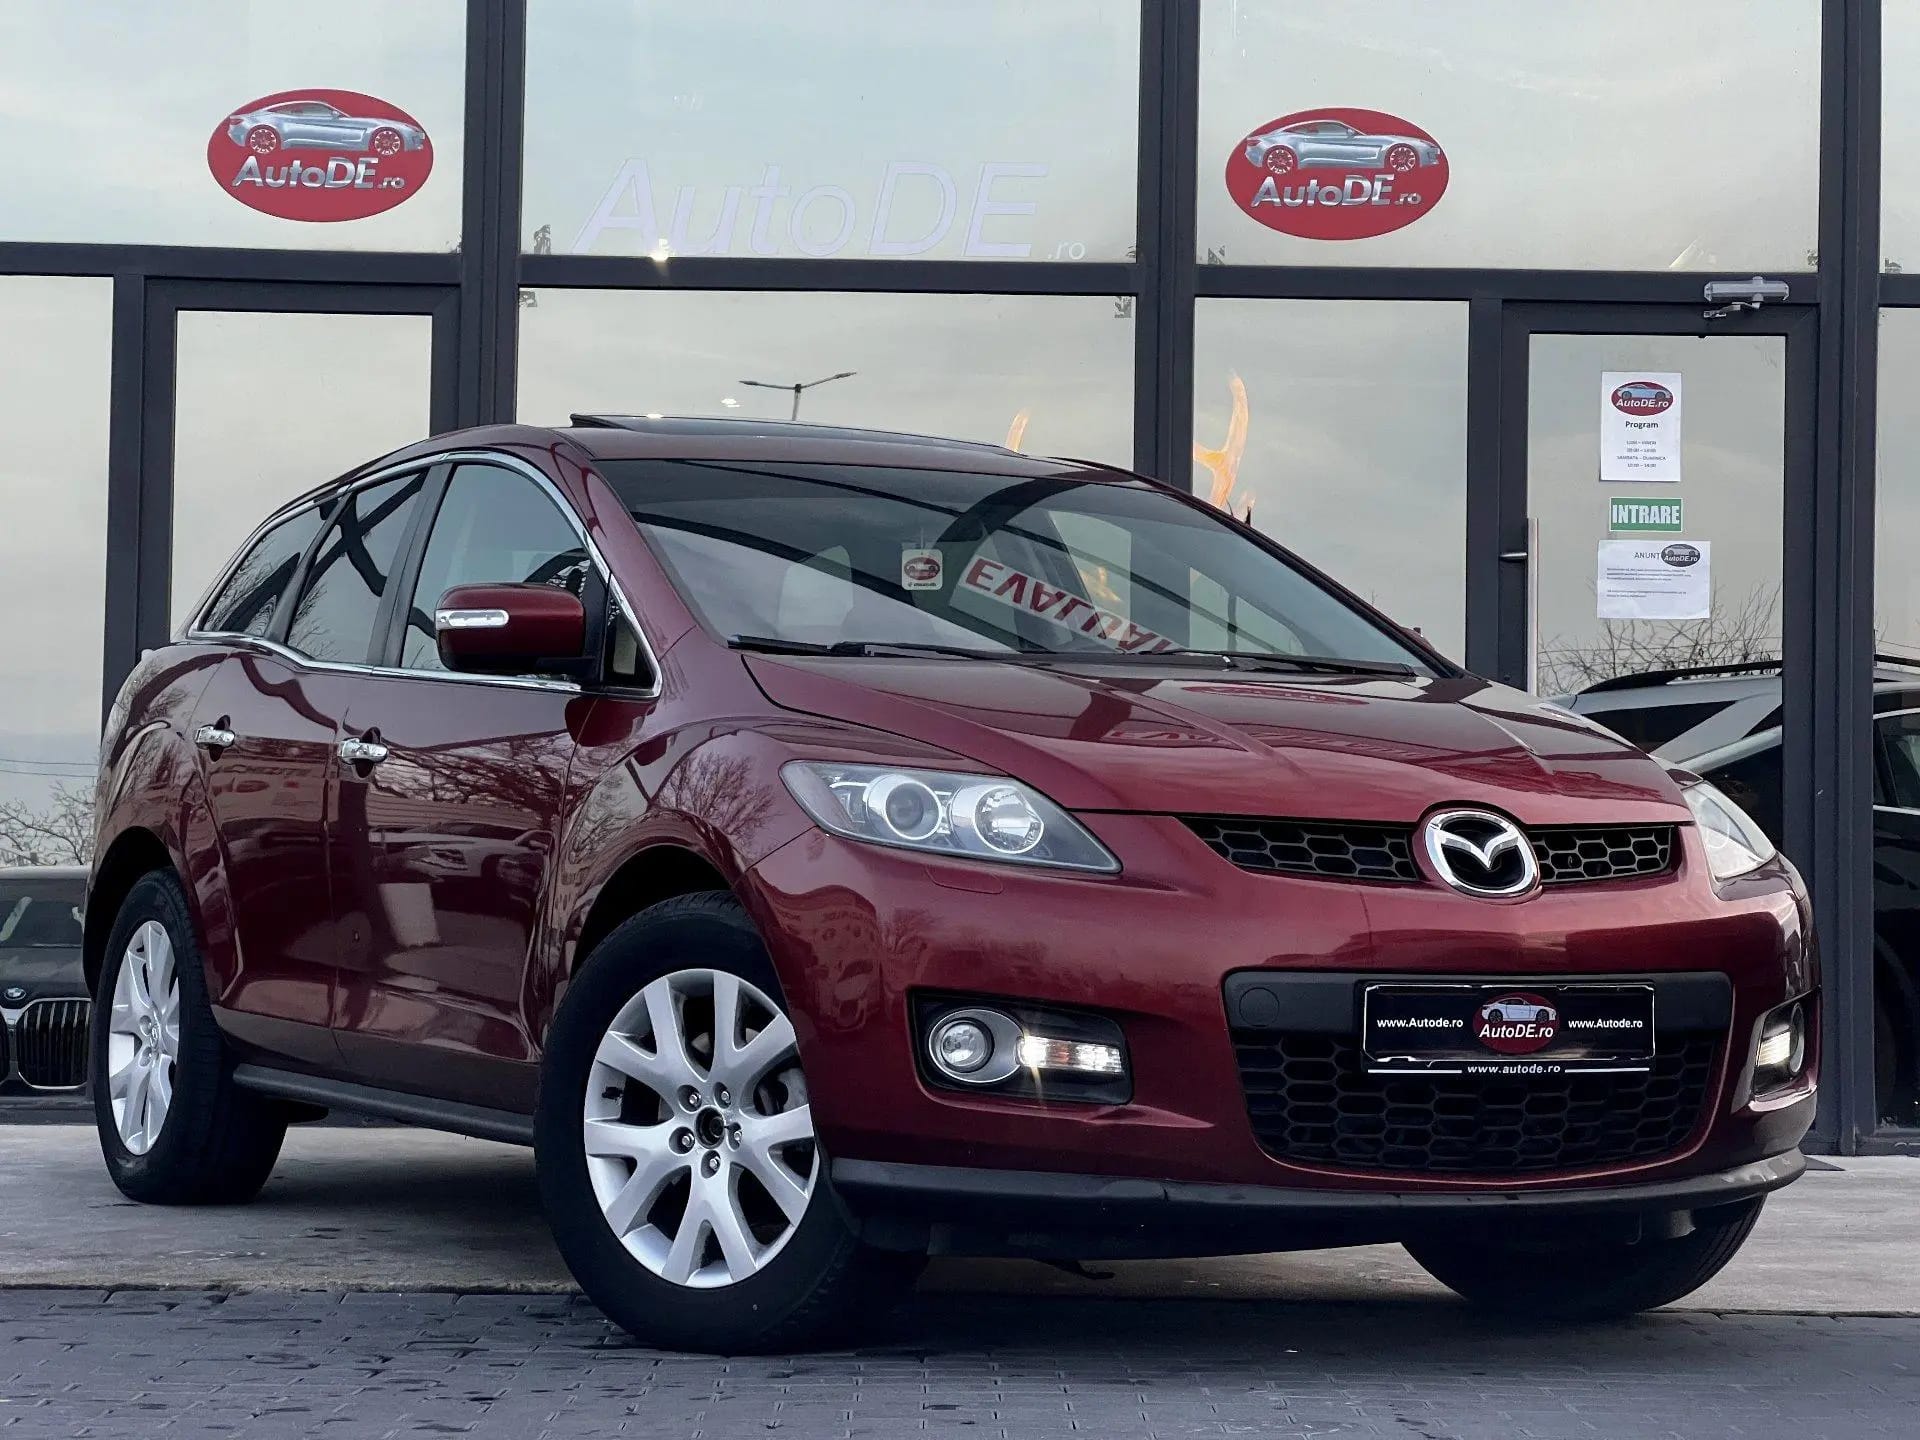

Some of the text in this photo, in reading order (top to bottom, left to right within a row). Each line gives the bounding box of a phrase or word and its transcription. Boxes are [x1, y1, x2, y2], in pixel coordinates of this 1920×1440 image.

[1616, 399, 1669, 408] AutoDE.ro
[1625, 421, 1658, 429] Program
[1612, 505, 1680, 524] INTRARE
[1376, 1017, 1464, 1029] www.Autode.ro
[1568, 1018, 1643, 1030] www.Autode.ro
[1478, 1023, 1554, 1039] AutoDE.ro
[1467, 1063, 1561, 1074] www.autode.ro
